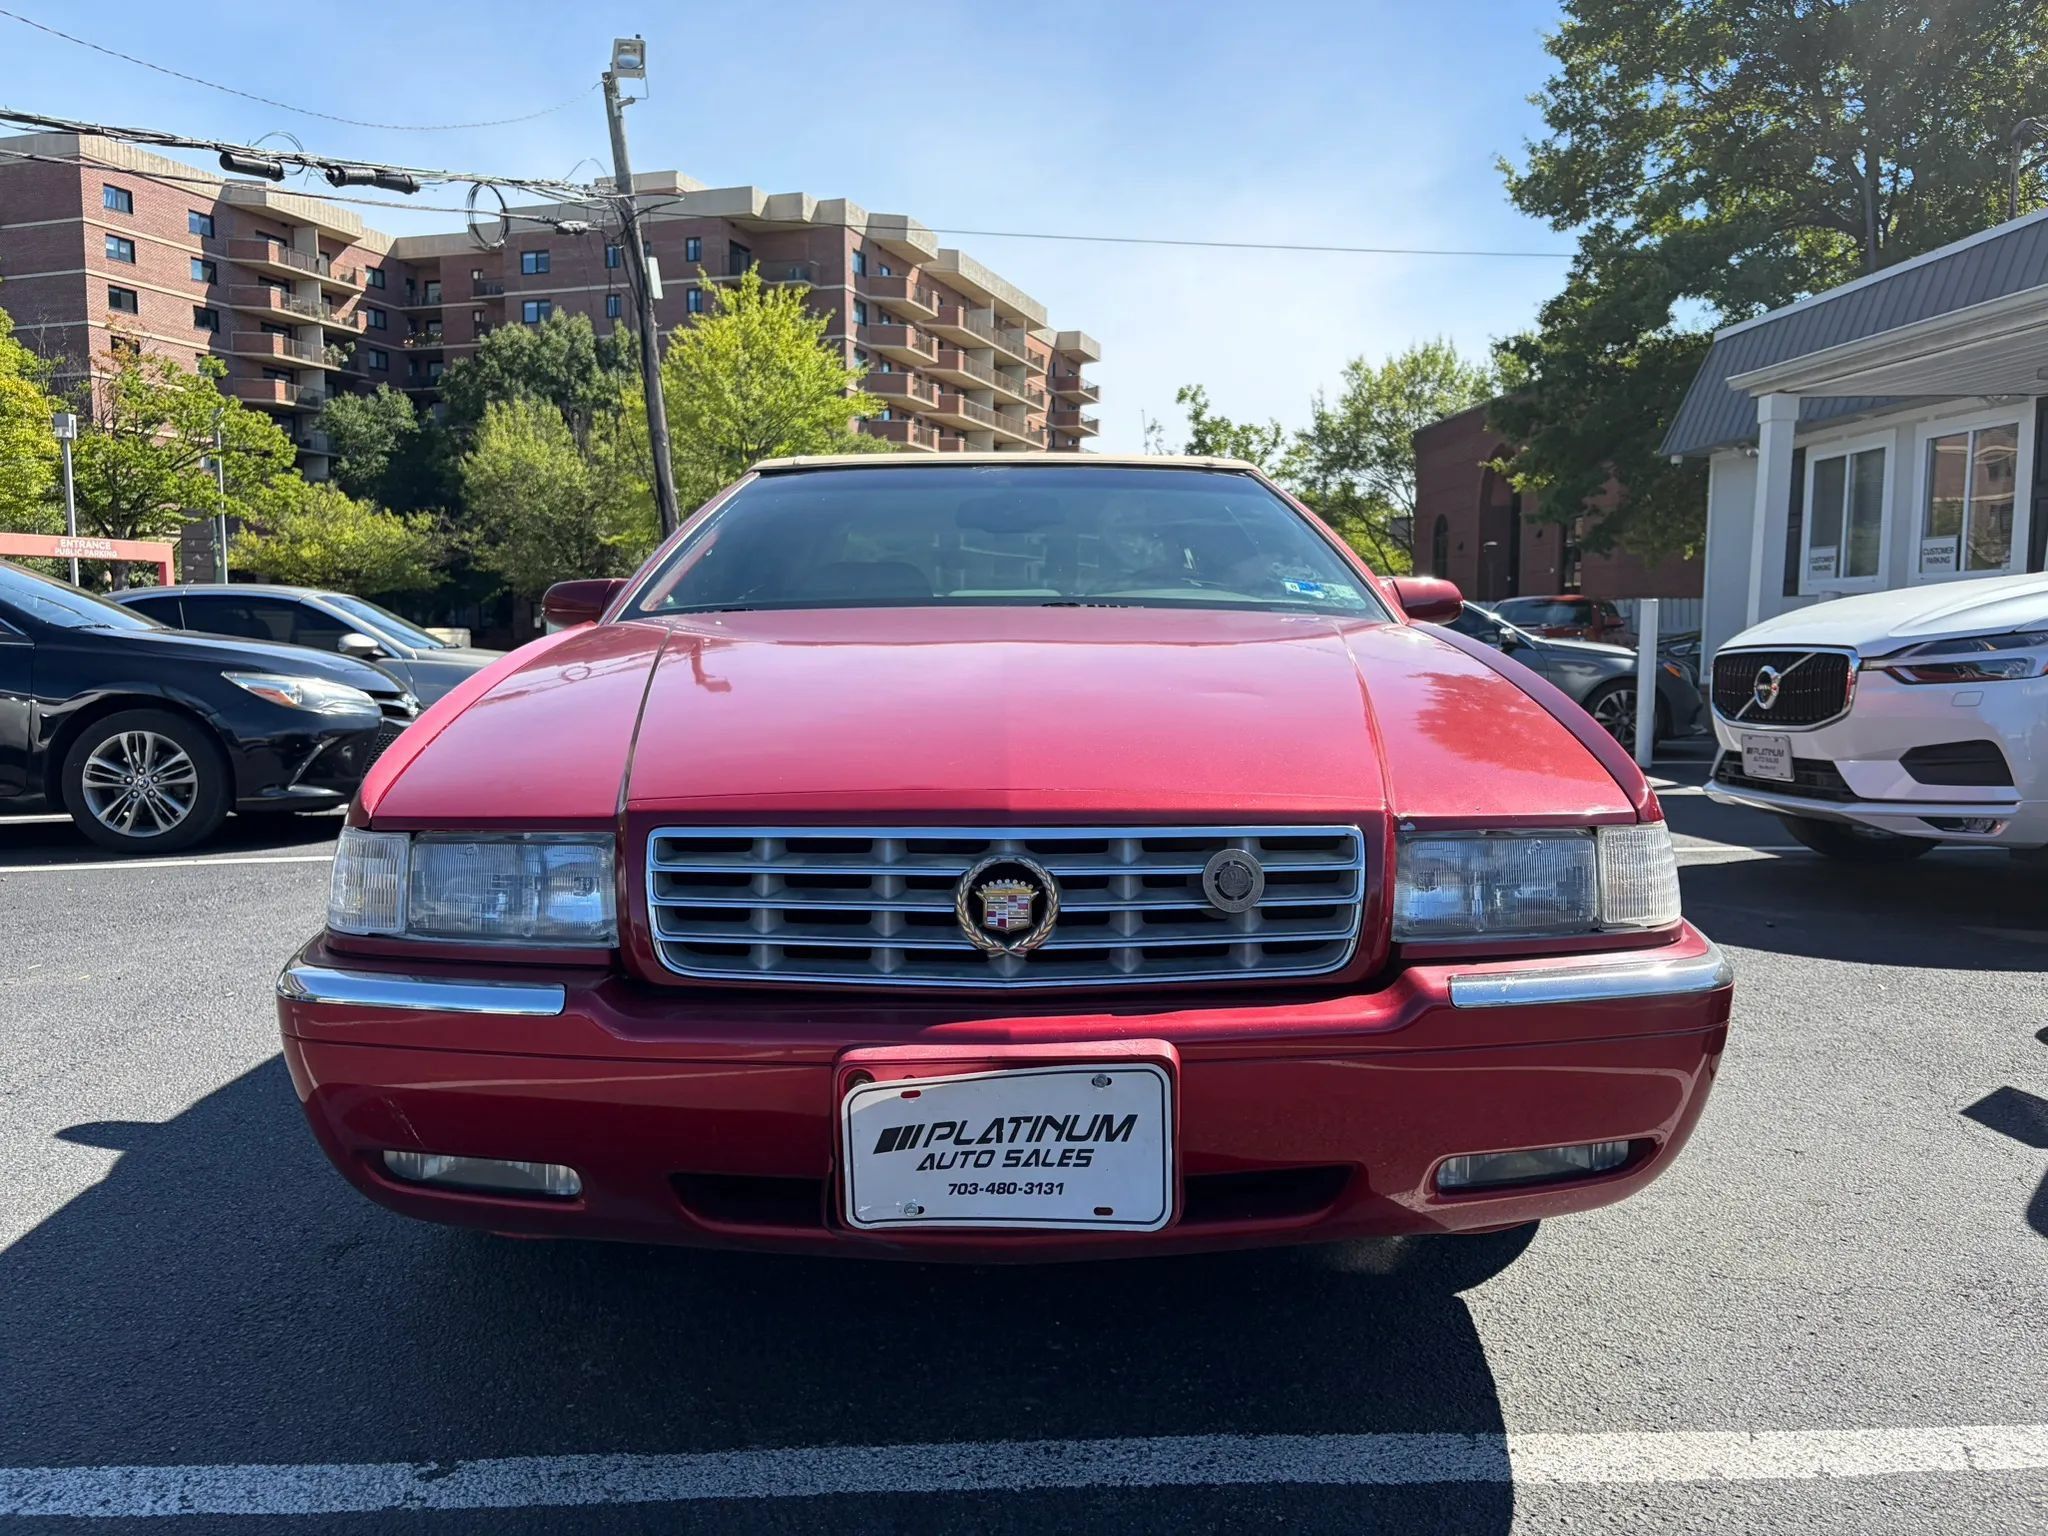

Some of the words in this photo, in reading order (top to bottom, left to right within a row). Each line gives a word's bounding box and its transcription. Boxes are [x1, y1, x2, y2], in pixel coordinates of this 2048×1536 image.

[60, 539, 112, 550] ENTRANCE
[54, 547, 83, 557] PUBLIC
[84, 549, 118, 558] PARKING
[1922, 546, 1955, 556] CUSTOMER
[1925, 556, 1951, 564] PARKING
[922, 1114, 1139, 1148] PLATINUM
[916, 1149, 996, 1171] AUTO
[1002, 1148, 1095, 1168] SALES
[948, 1182, 1064, 1196] 703-480-3131
